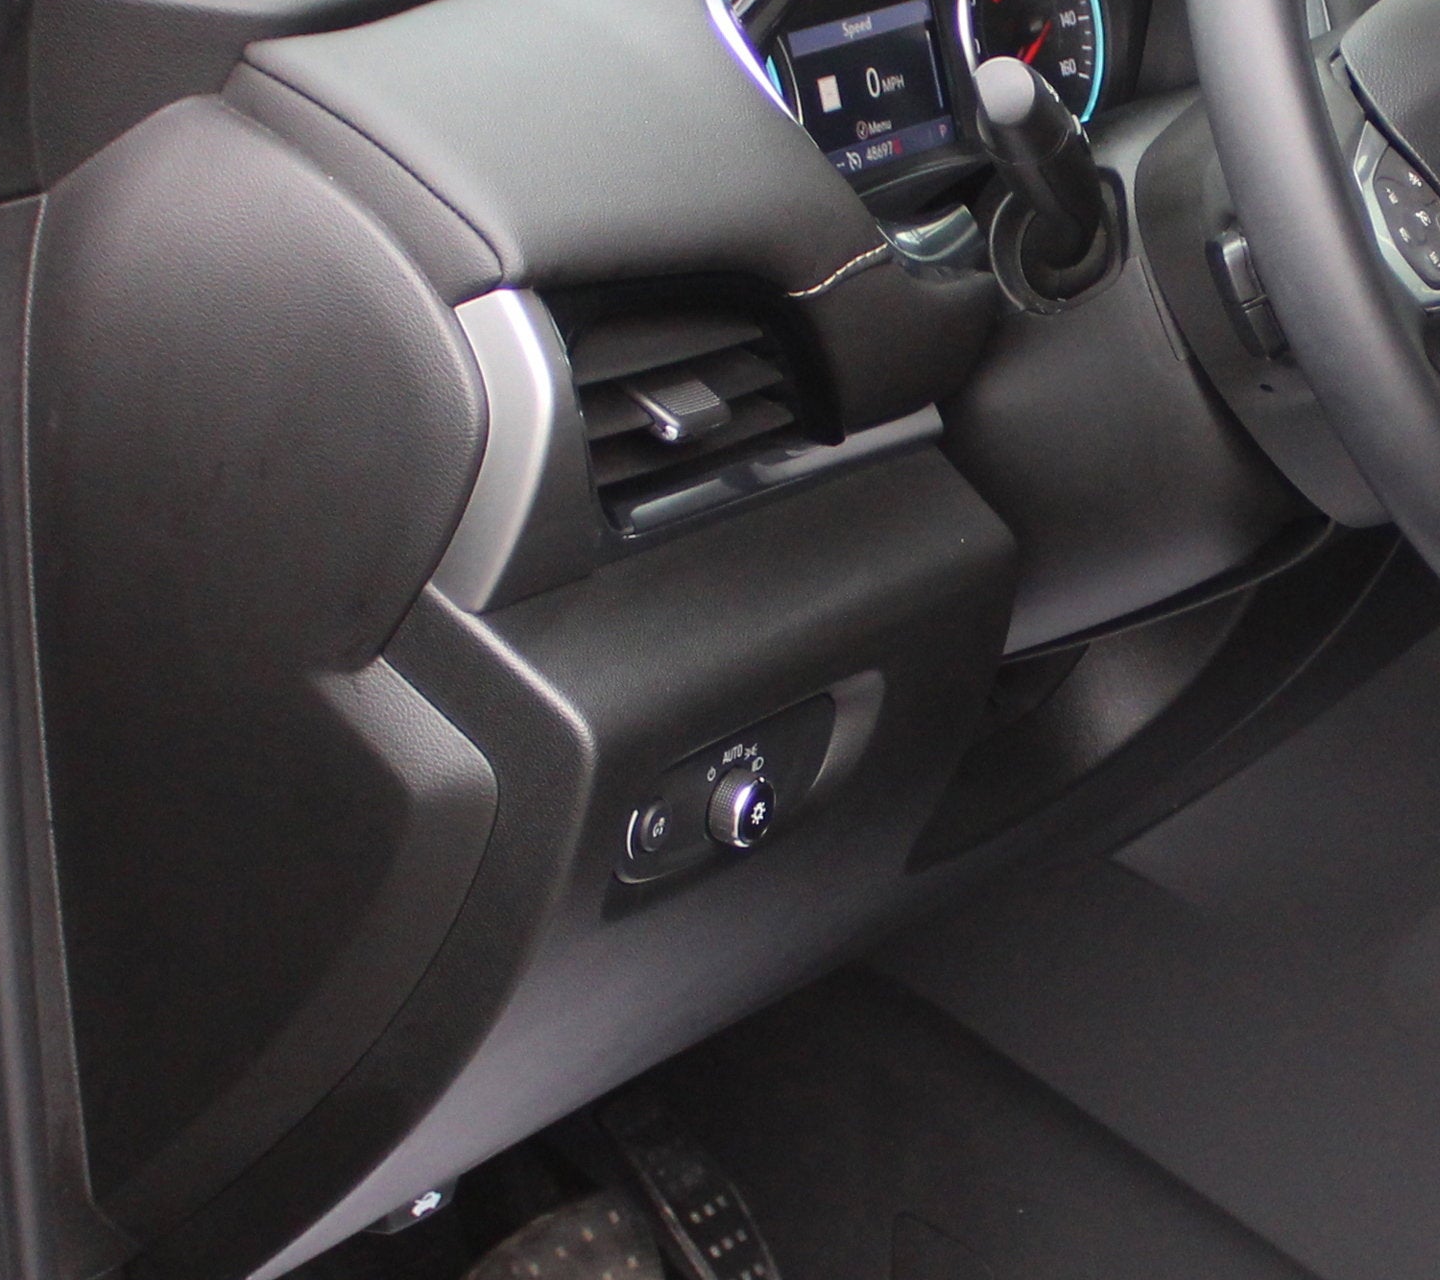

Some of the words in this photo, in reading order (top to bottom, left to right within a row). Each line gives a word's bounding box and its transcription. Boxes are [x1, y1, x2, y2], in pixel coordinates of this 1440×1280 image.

[841, 16, 872, 39] Speed
[1060, 10, 1076, 28] 140
[1059, 58, 1076, 77] 160
[881, 74, 905, 93] MPH
[867, 120, 892, 135] Menu
[722, 743, 743, 765] AUTO
